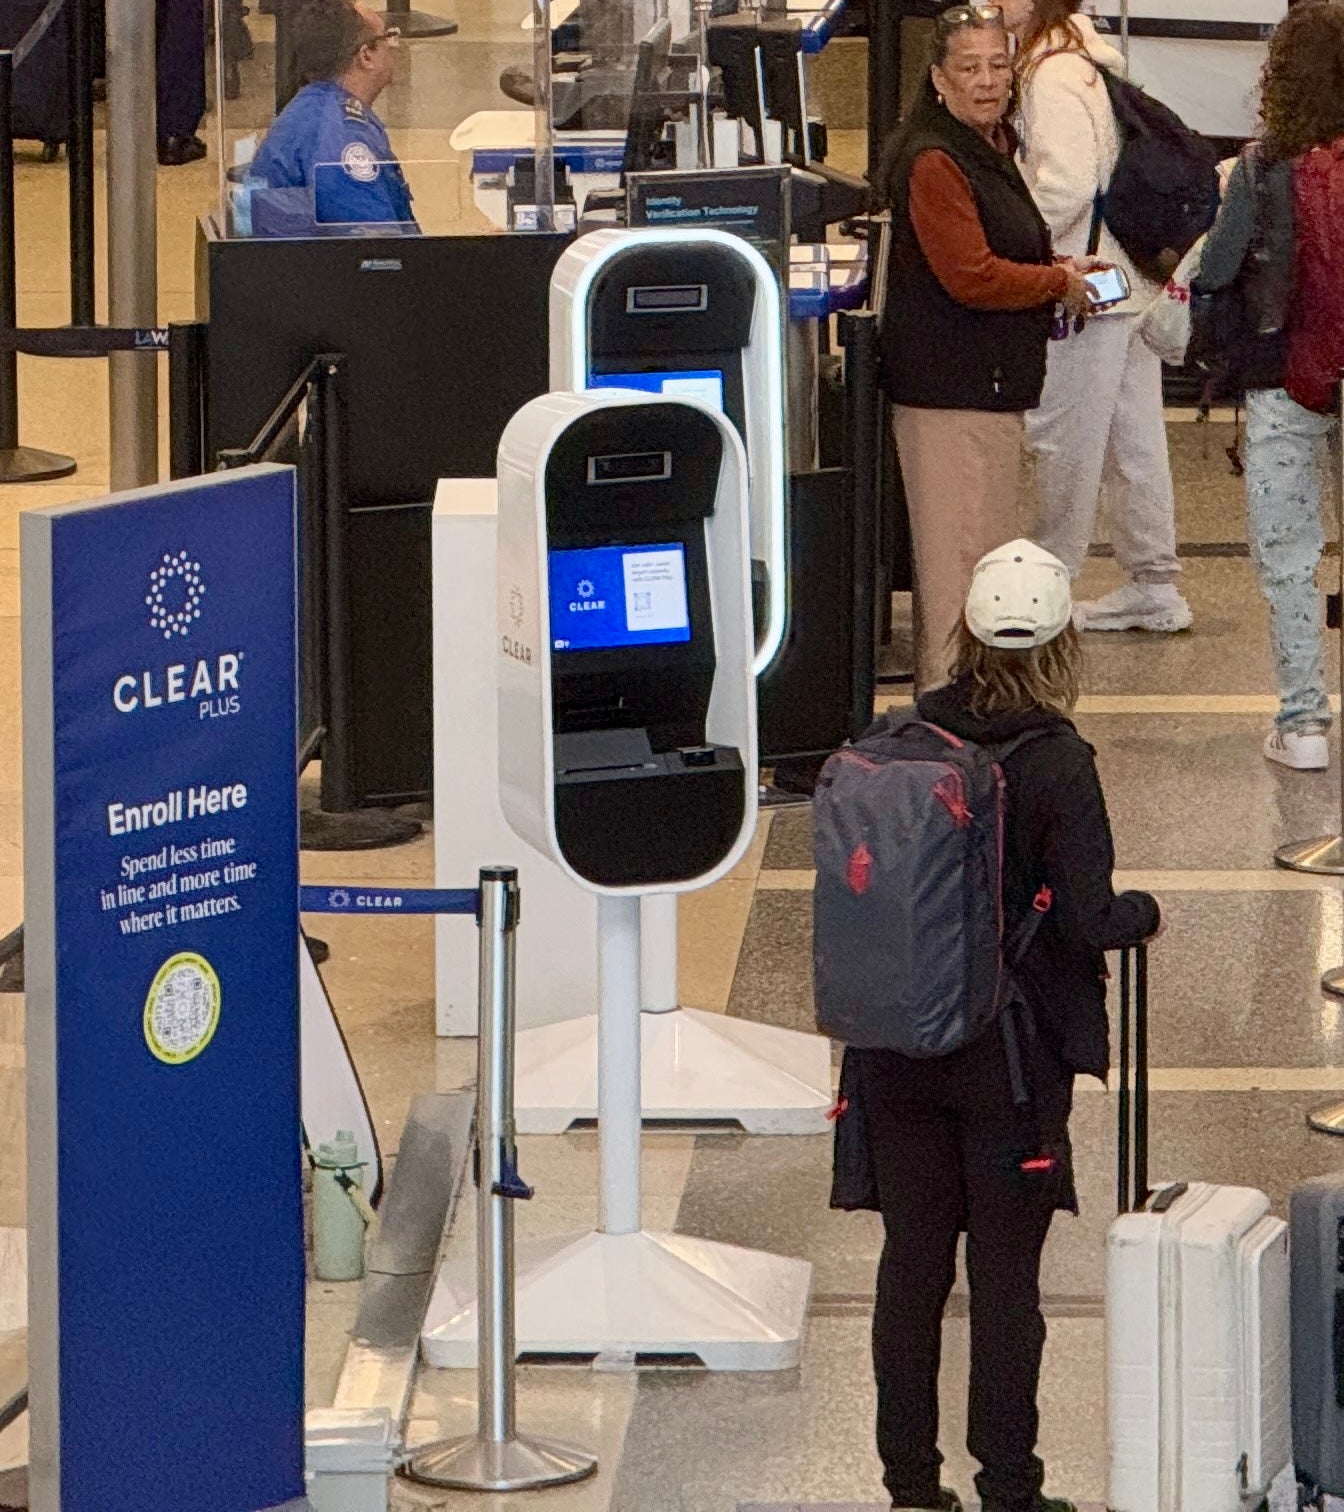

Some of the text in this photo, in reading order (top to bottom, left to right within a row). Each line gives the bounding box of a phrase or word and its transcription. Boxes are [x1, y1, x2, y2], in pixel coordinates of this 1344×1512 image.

[135, 329, 169, 346] LAW
[569, 599, 606, 612] CLEAR
[502, 635, 532, 666] CLEAR
[113, 653, 240, 713] CLEAR
[199, 695, 241, 720] PLUS
[107, 783, 248, 836] Enroll Here
[120, 837, 236, 880] Spend less time
[101, 861, 257, 911] in line and more time
[356, 895, 403, 907] CLEAR
[119, 894, 242, 935] where it matters.
